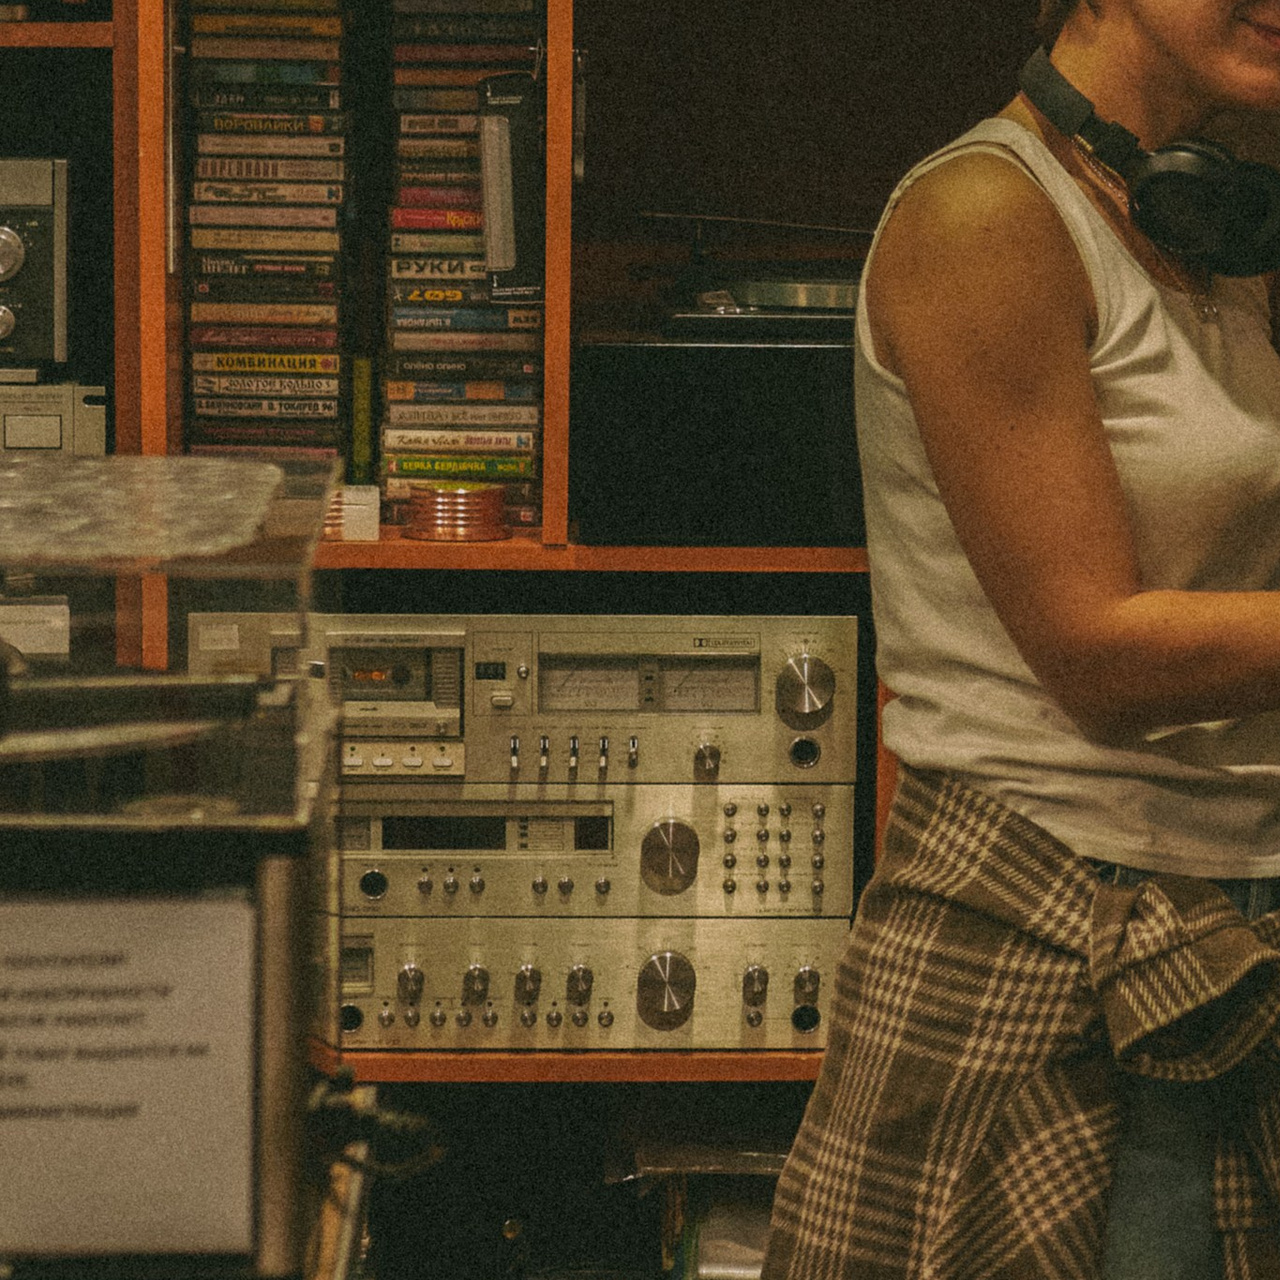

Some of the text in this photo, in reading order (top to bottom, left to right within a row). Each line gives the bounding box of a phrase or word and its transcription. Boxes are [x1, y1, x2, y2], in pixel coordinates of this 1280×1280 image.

[397, 261, 466, 274] РУКИ
[216, 356, 317, 369] КОМБИНАЦИЯ
[402, 461, 432, 471] ВЕРКА
